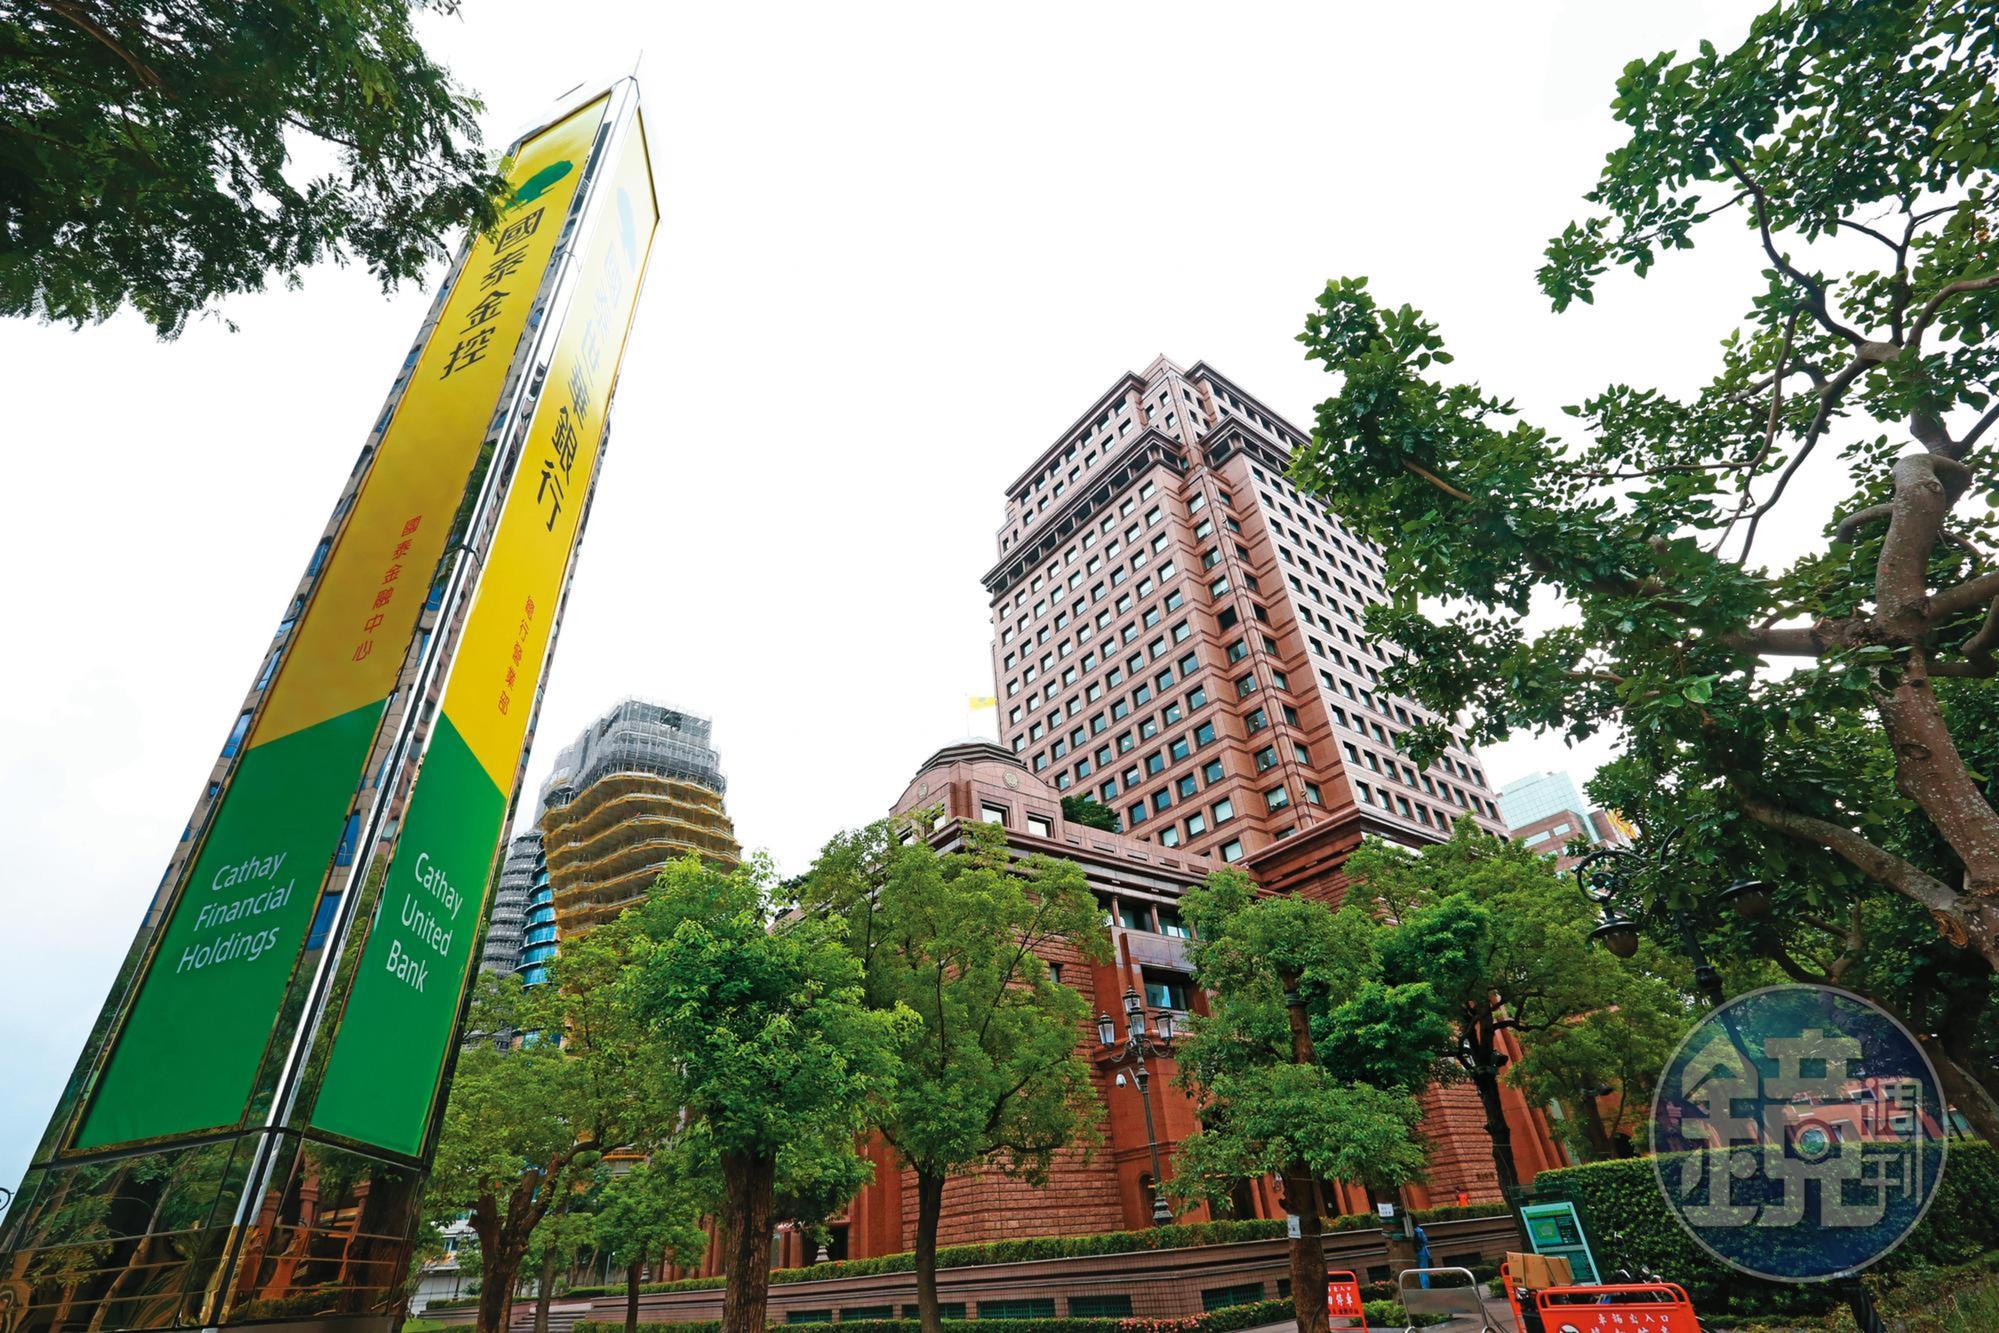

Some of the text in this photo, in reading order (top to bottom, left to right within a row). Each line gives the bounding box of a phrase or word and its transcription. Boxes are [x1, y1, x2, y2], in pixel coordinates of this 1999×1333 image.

[440, 207, 545, 380] 國泰金控
[352, 515, 422, 662] 國泰金融中心
[211, 851, 288, 892] Cathay
[413, 852, 464, 920] Cathay
[193, 878, 295, 932] Financial
[401, 894, 454, 957] United
[176, 926, 281, 974] Holdings
[386, 939, 428, 992] Bank
